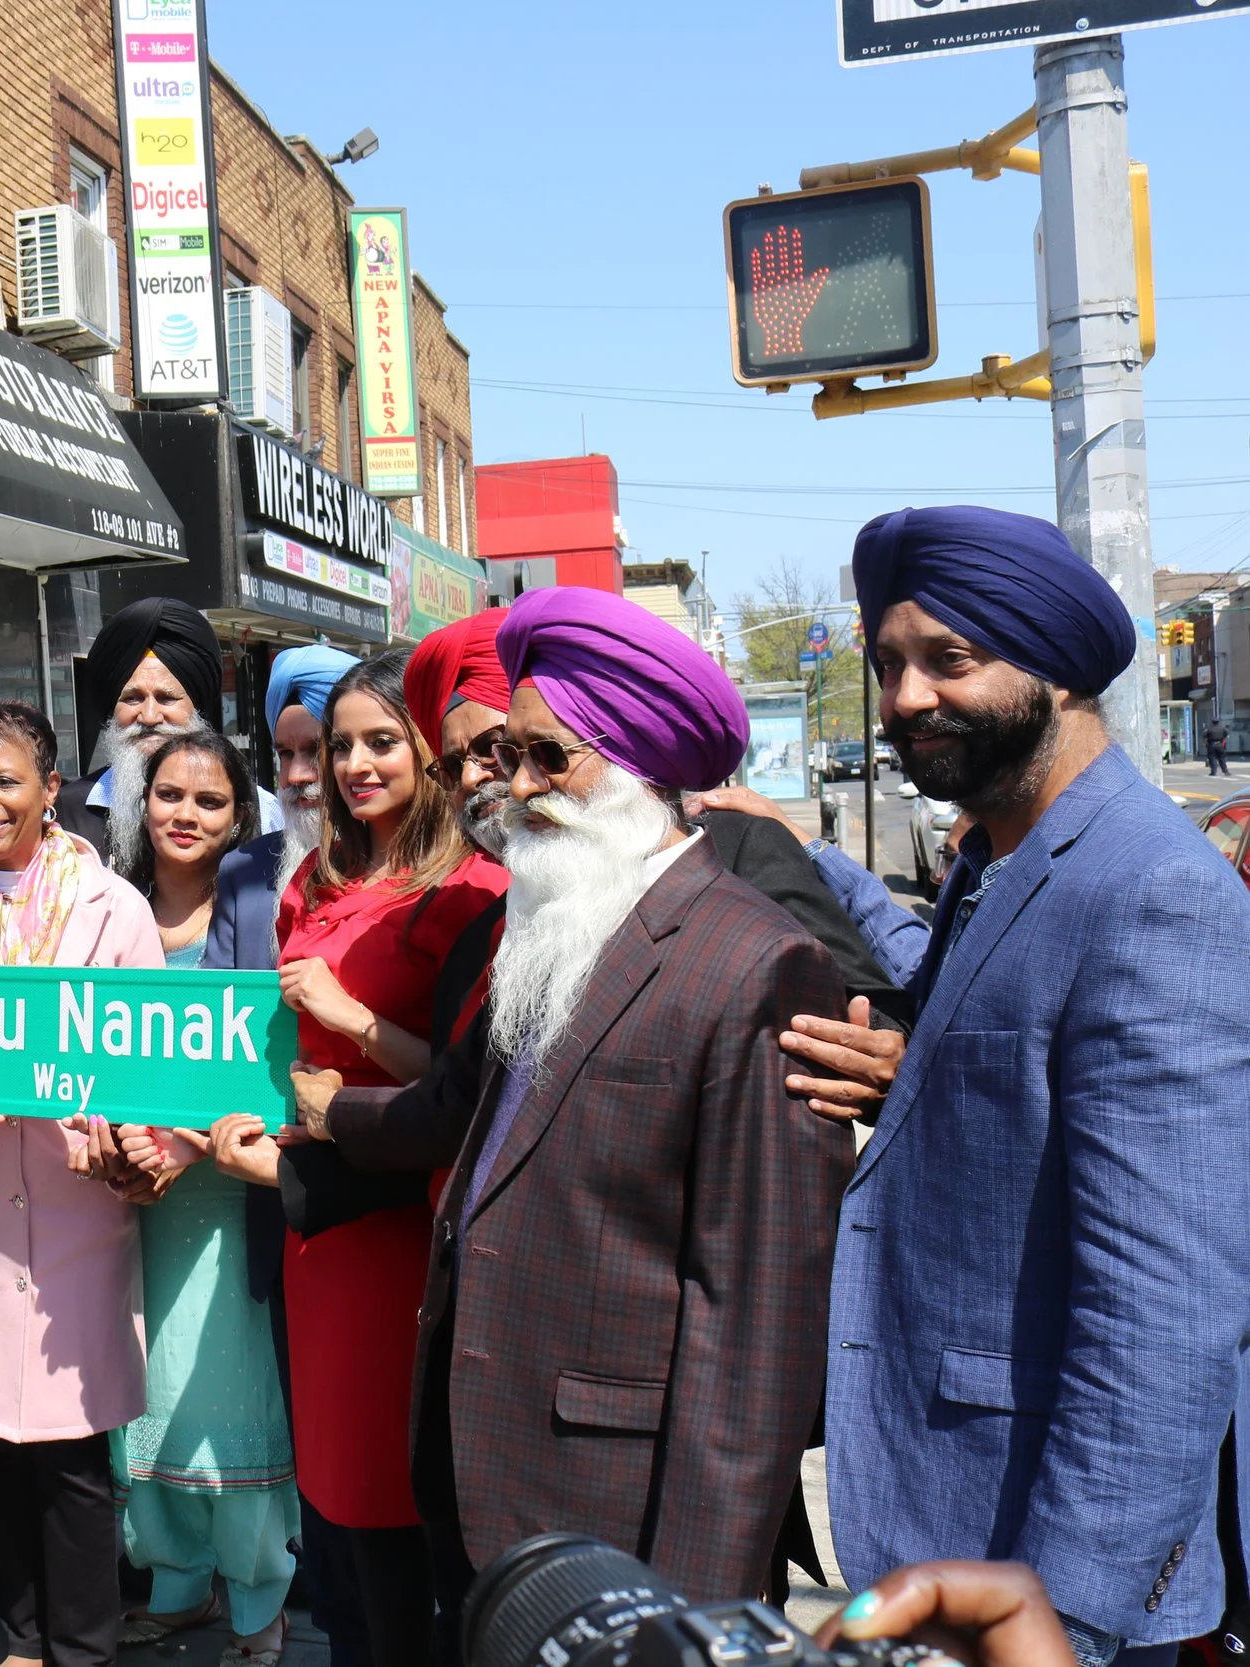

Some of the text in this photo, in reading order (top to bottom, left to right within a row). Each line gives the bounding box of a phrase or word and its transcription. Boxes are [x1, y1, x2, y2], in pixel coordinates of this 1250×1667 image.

[862, 25, 1042, 55] DEPT OF TRANSPORTATION
[133, 77, 180, 97] ultra
[131, 181, 208, 218] Digicel
[138, 271, 206, 295] verizon
[364, 279, 398, 292] NEW
[375, 296, 392, 354] APNA
[150, 358, 213, 380] AT&T
[379, 361, 398, 435] VIRSA
[40, 432, 141, 493] ACCOUNTANT
[252, 434, 393, 566] WIRELESS WORLD
[91, 508, 179, 550] 118-03 101 AVE #2
[262, 579, 285, 605] PREPAID
[287, 587, 308, 612] PHONES
[312, 594, 342, 621] ACCESSORIES
[57, 980, 259, 1063] Nanak
[33, 1062, 96, 1113] Way
